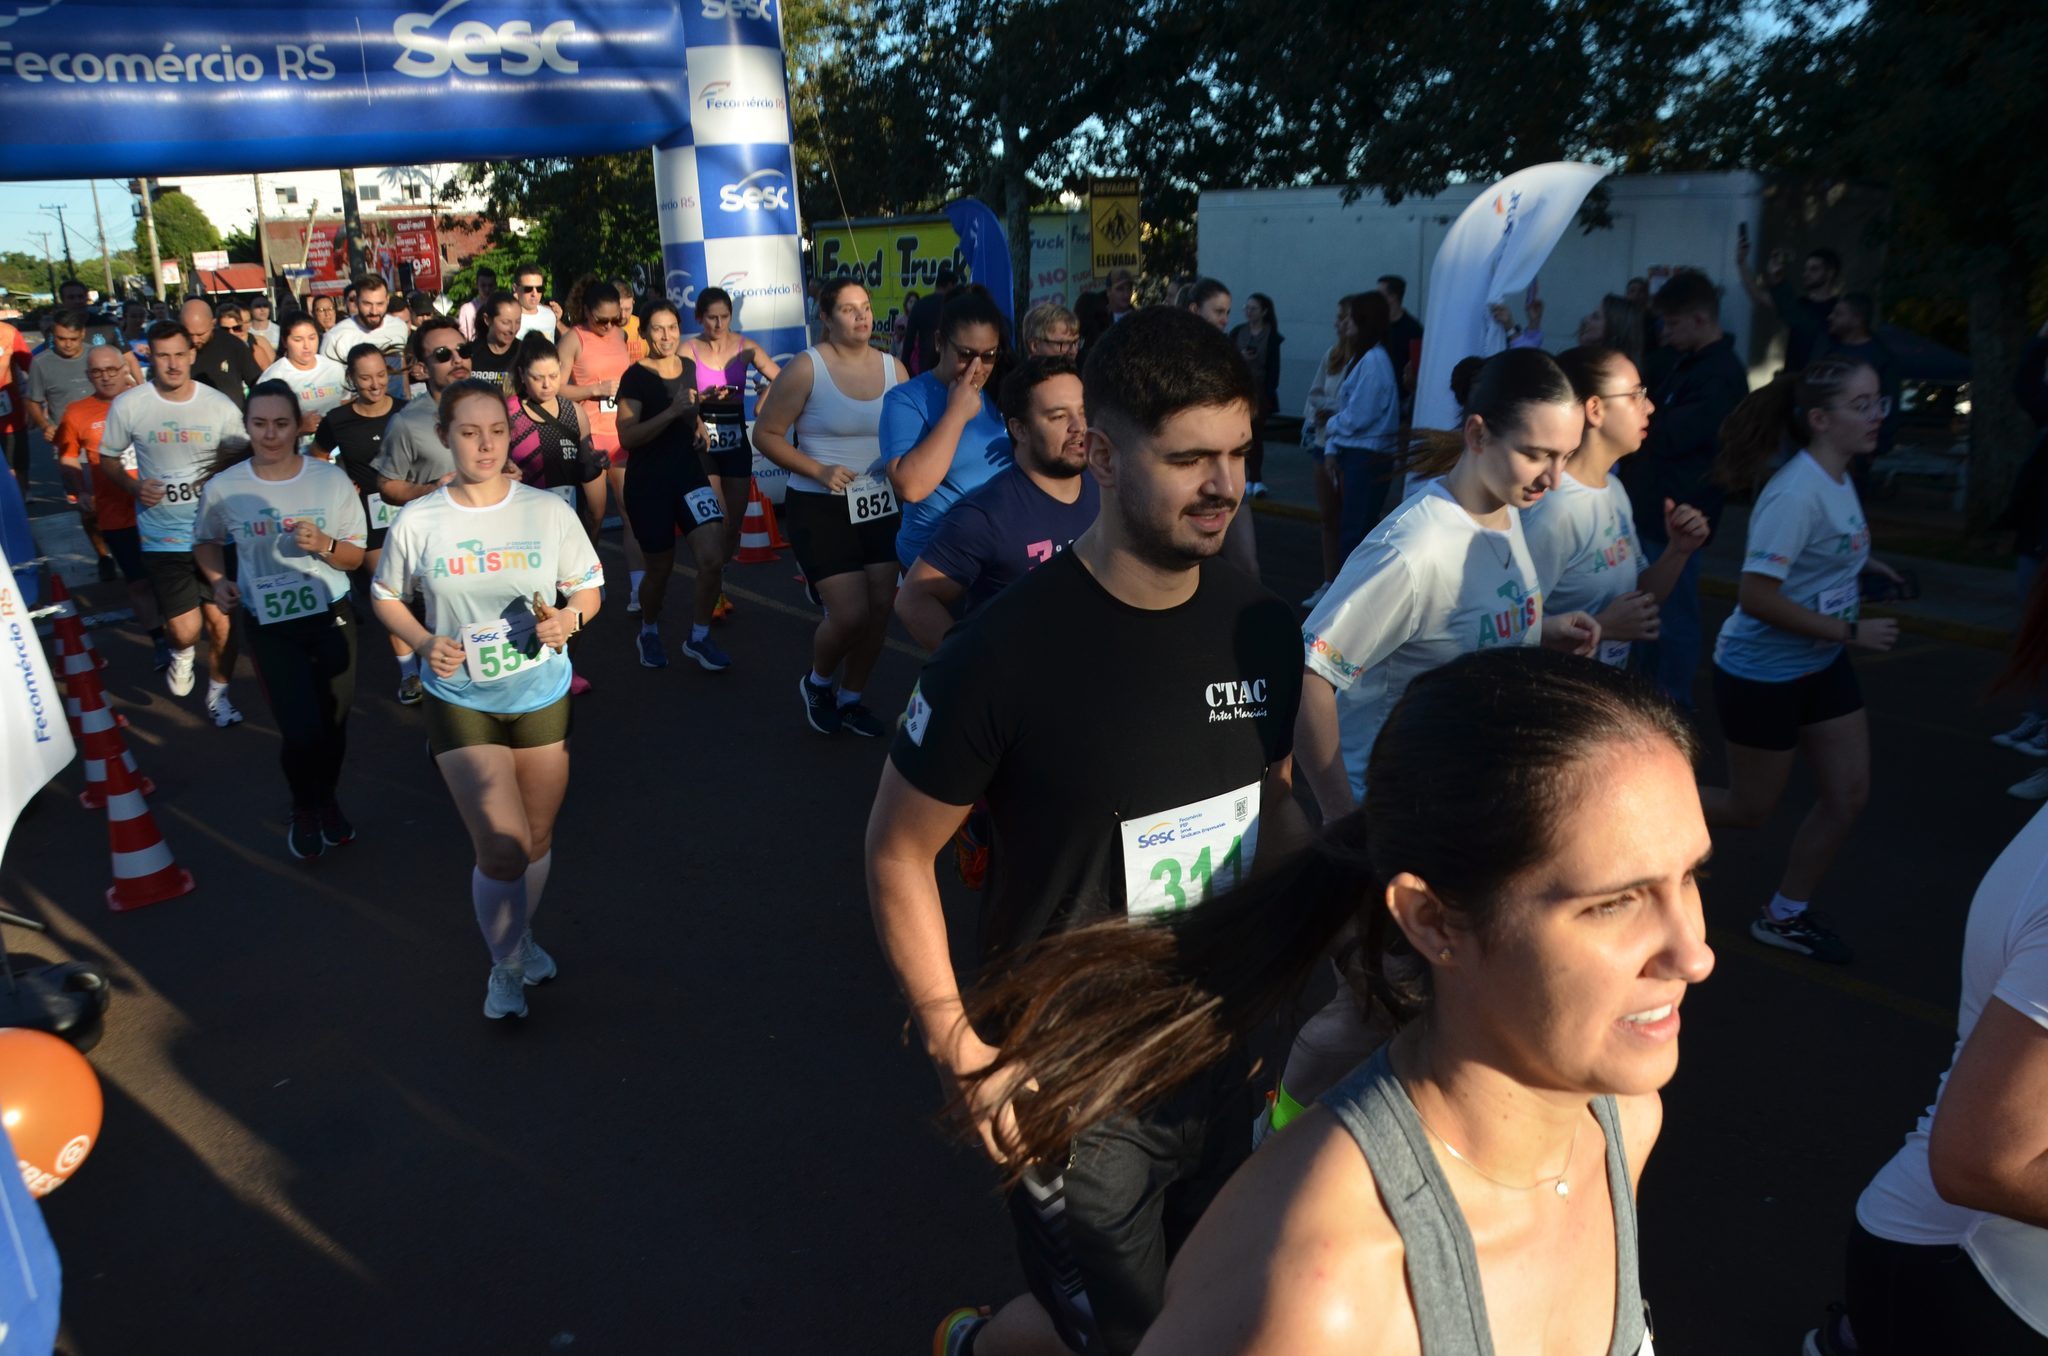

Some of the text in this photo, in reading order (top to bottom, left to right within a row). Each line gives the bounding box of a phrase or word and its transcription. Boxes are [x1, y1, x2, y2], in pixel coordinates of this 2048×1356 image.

[393, 8, 579, 78] Sesc
[278, 44, 336, 81] RS
[706, 97, 773, 110] Fecomércio
[681, 197, 695, 208] RS
[719, 178, 789, 212] Sesc
[1029, 229, 1065, 249] ruck
[822, 235, 969, 287] Food Truck
[1096, 253, 1138, 267] ELEVADA
[148, 430, 212, 443] Autismo
[857, 491, 892, 518] 852
[433, 550, 542, 579] Autismo
[264, 585, 317, 618] 526
[471, 631, 500, 643] Sesc
[10, 622, 51, 743] Fecomércio
[1205, 679, 1267, 707] CTAC
[1209, 705, 1267, 723] Artes Marciais
[1138, 829, 1176, 849] Sesc
[1150, 834, 1243, 921] 311
